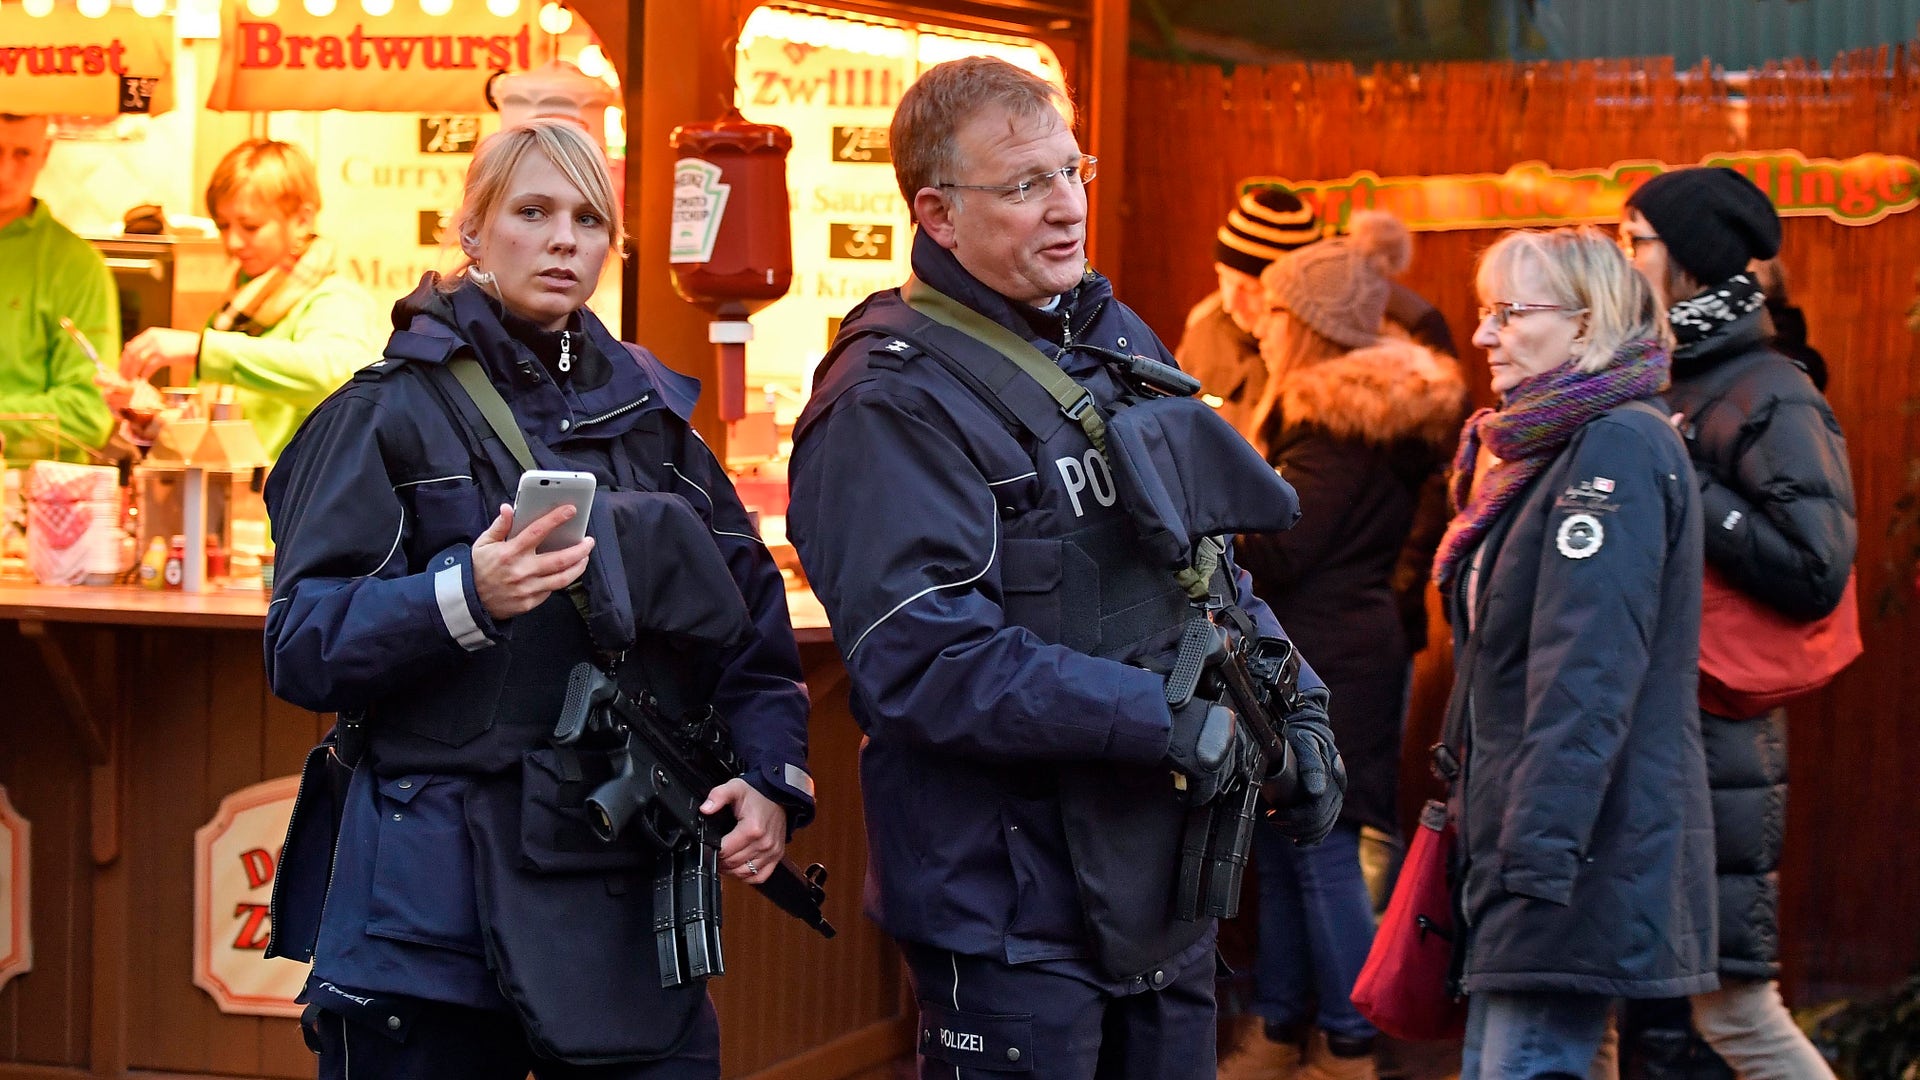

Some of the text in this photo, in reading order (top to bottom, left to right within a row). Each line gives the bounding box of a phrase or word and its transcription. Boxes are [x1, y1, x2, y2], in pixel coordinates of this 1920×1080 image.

[0, 39, 128, 76] wurst
[239, 22, 531, 70] Bratwurst
[813, 186, 906, 215] Sauer
[1055, 448, 1117, 517] PO
[240, 846, 283, 889] D
[232, 902, 271, 950] Z
[940, 1027, 984, 1053] POLIZEI
